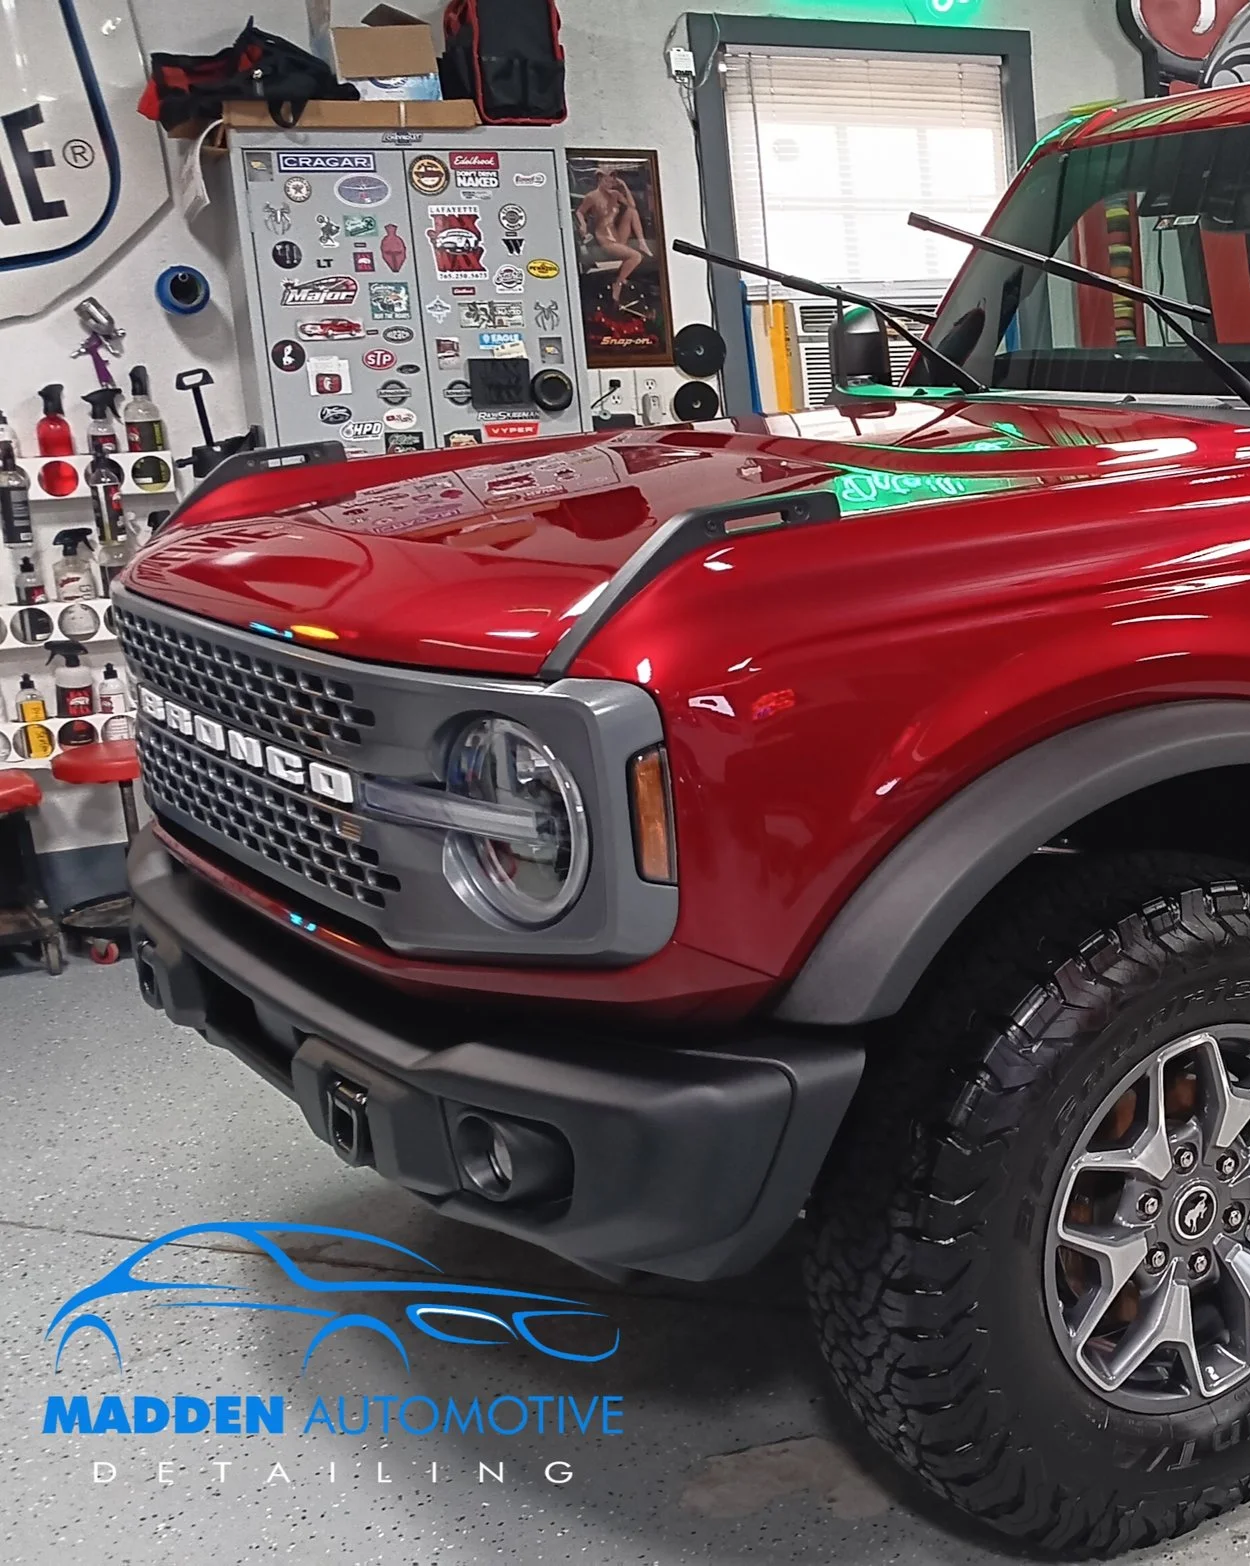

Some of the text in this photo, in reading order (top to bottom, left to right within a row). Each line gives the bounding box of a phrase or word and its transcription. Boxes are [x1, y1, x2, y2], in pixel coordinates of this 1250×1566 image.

[284, 157, 368, 167] CRAGAR
[457, 177, 498, 187] NAKED
[316, 259, 334, 268] LT
[286, 288, 355, 304] Major
[366, 351, 392, 366] STP
[139, 687, 354, 804] BRONCO
